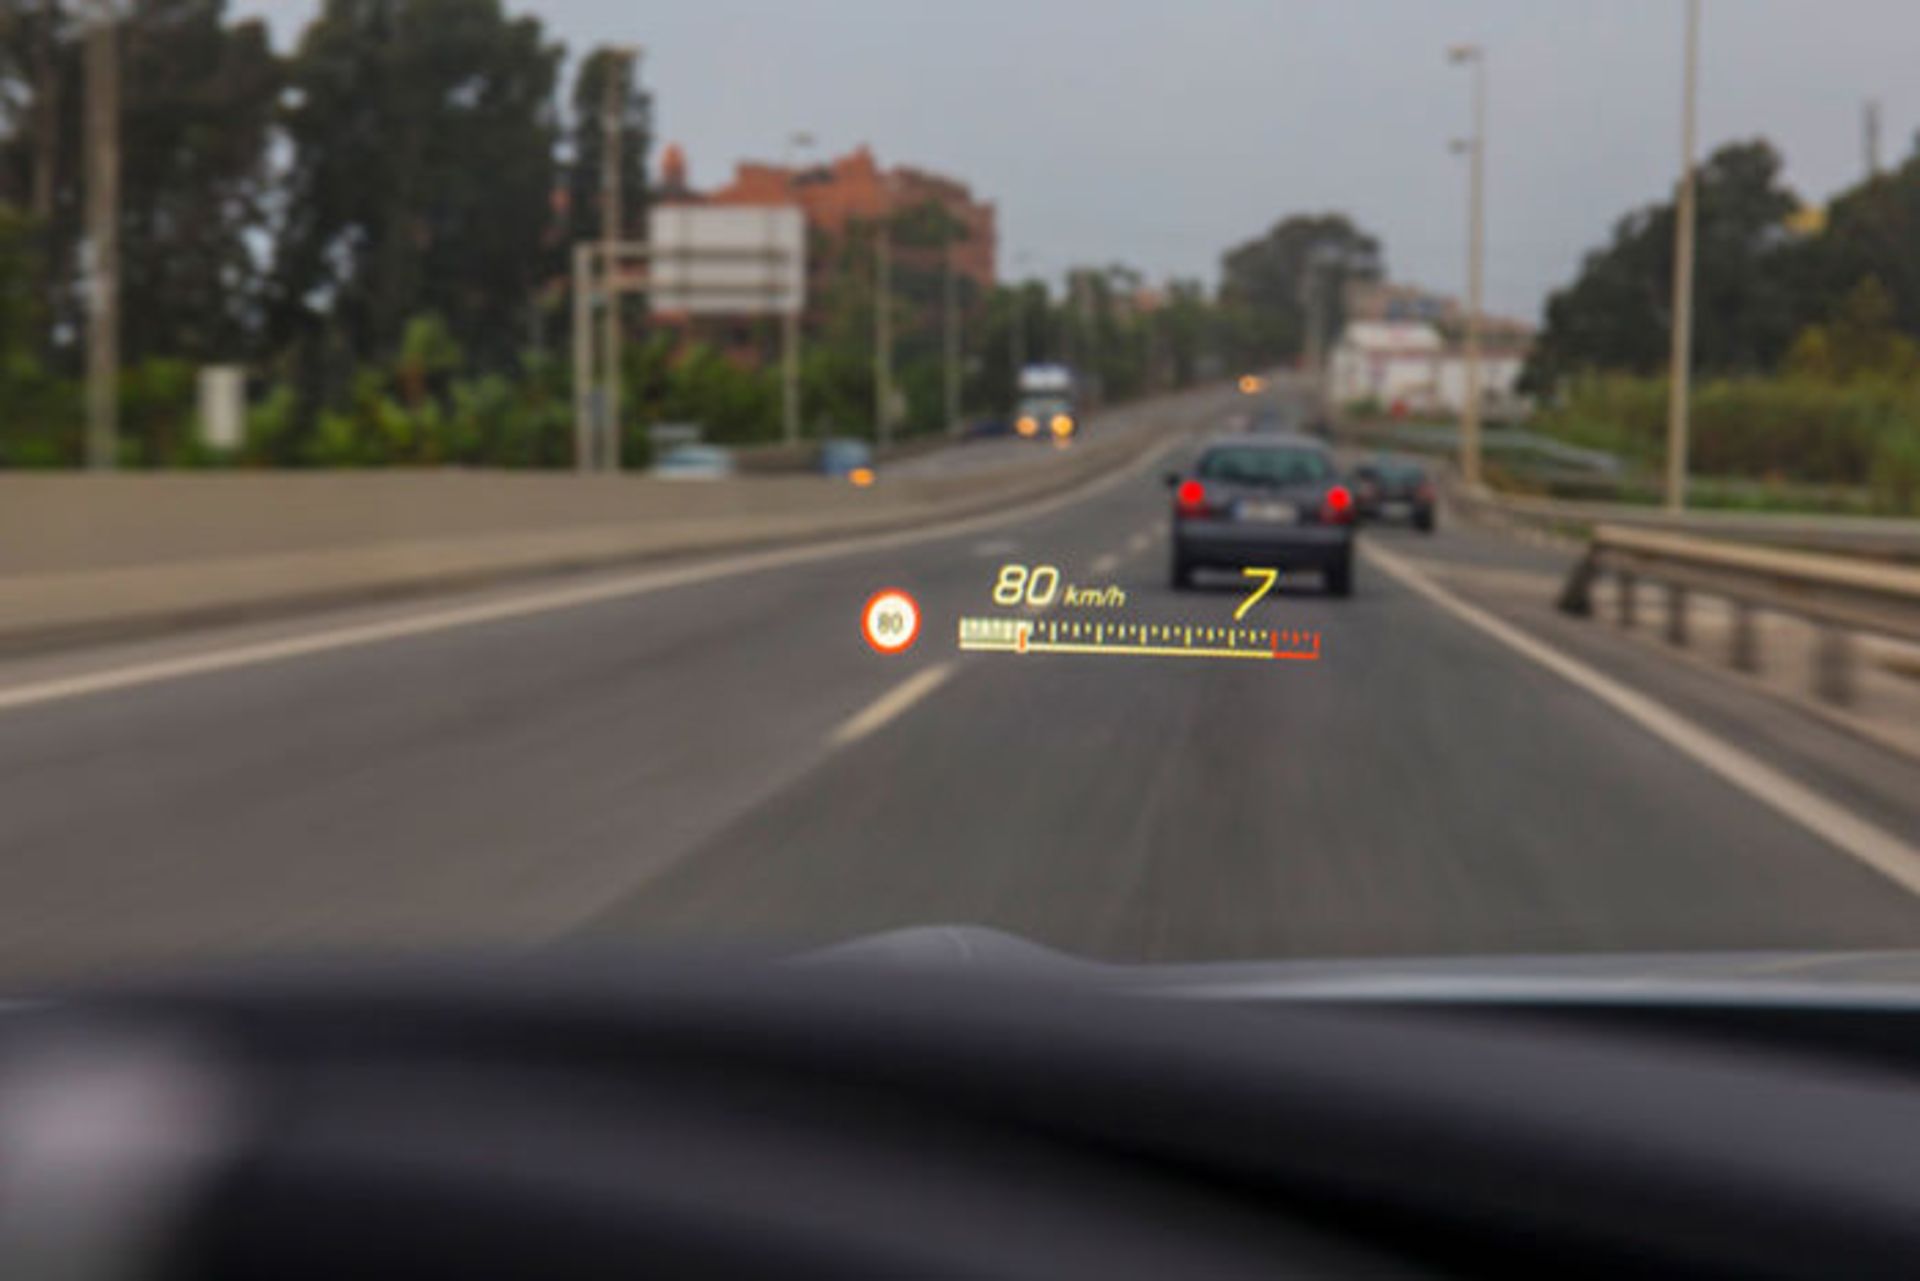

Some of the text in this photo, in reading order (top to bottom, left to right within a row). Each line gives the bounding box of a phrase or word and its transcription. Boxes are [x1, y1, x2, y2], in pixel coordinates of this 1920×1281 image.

[993, 564, 1126, 606] 80 km/h
[1233, 567, 1278, 620] 7
[877, 612, 904, 634] 80
